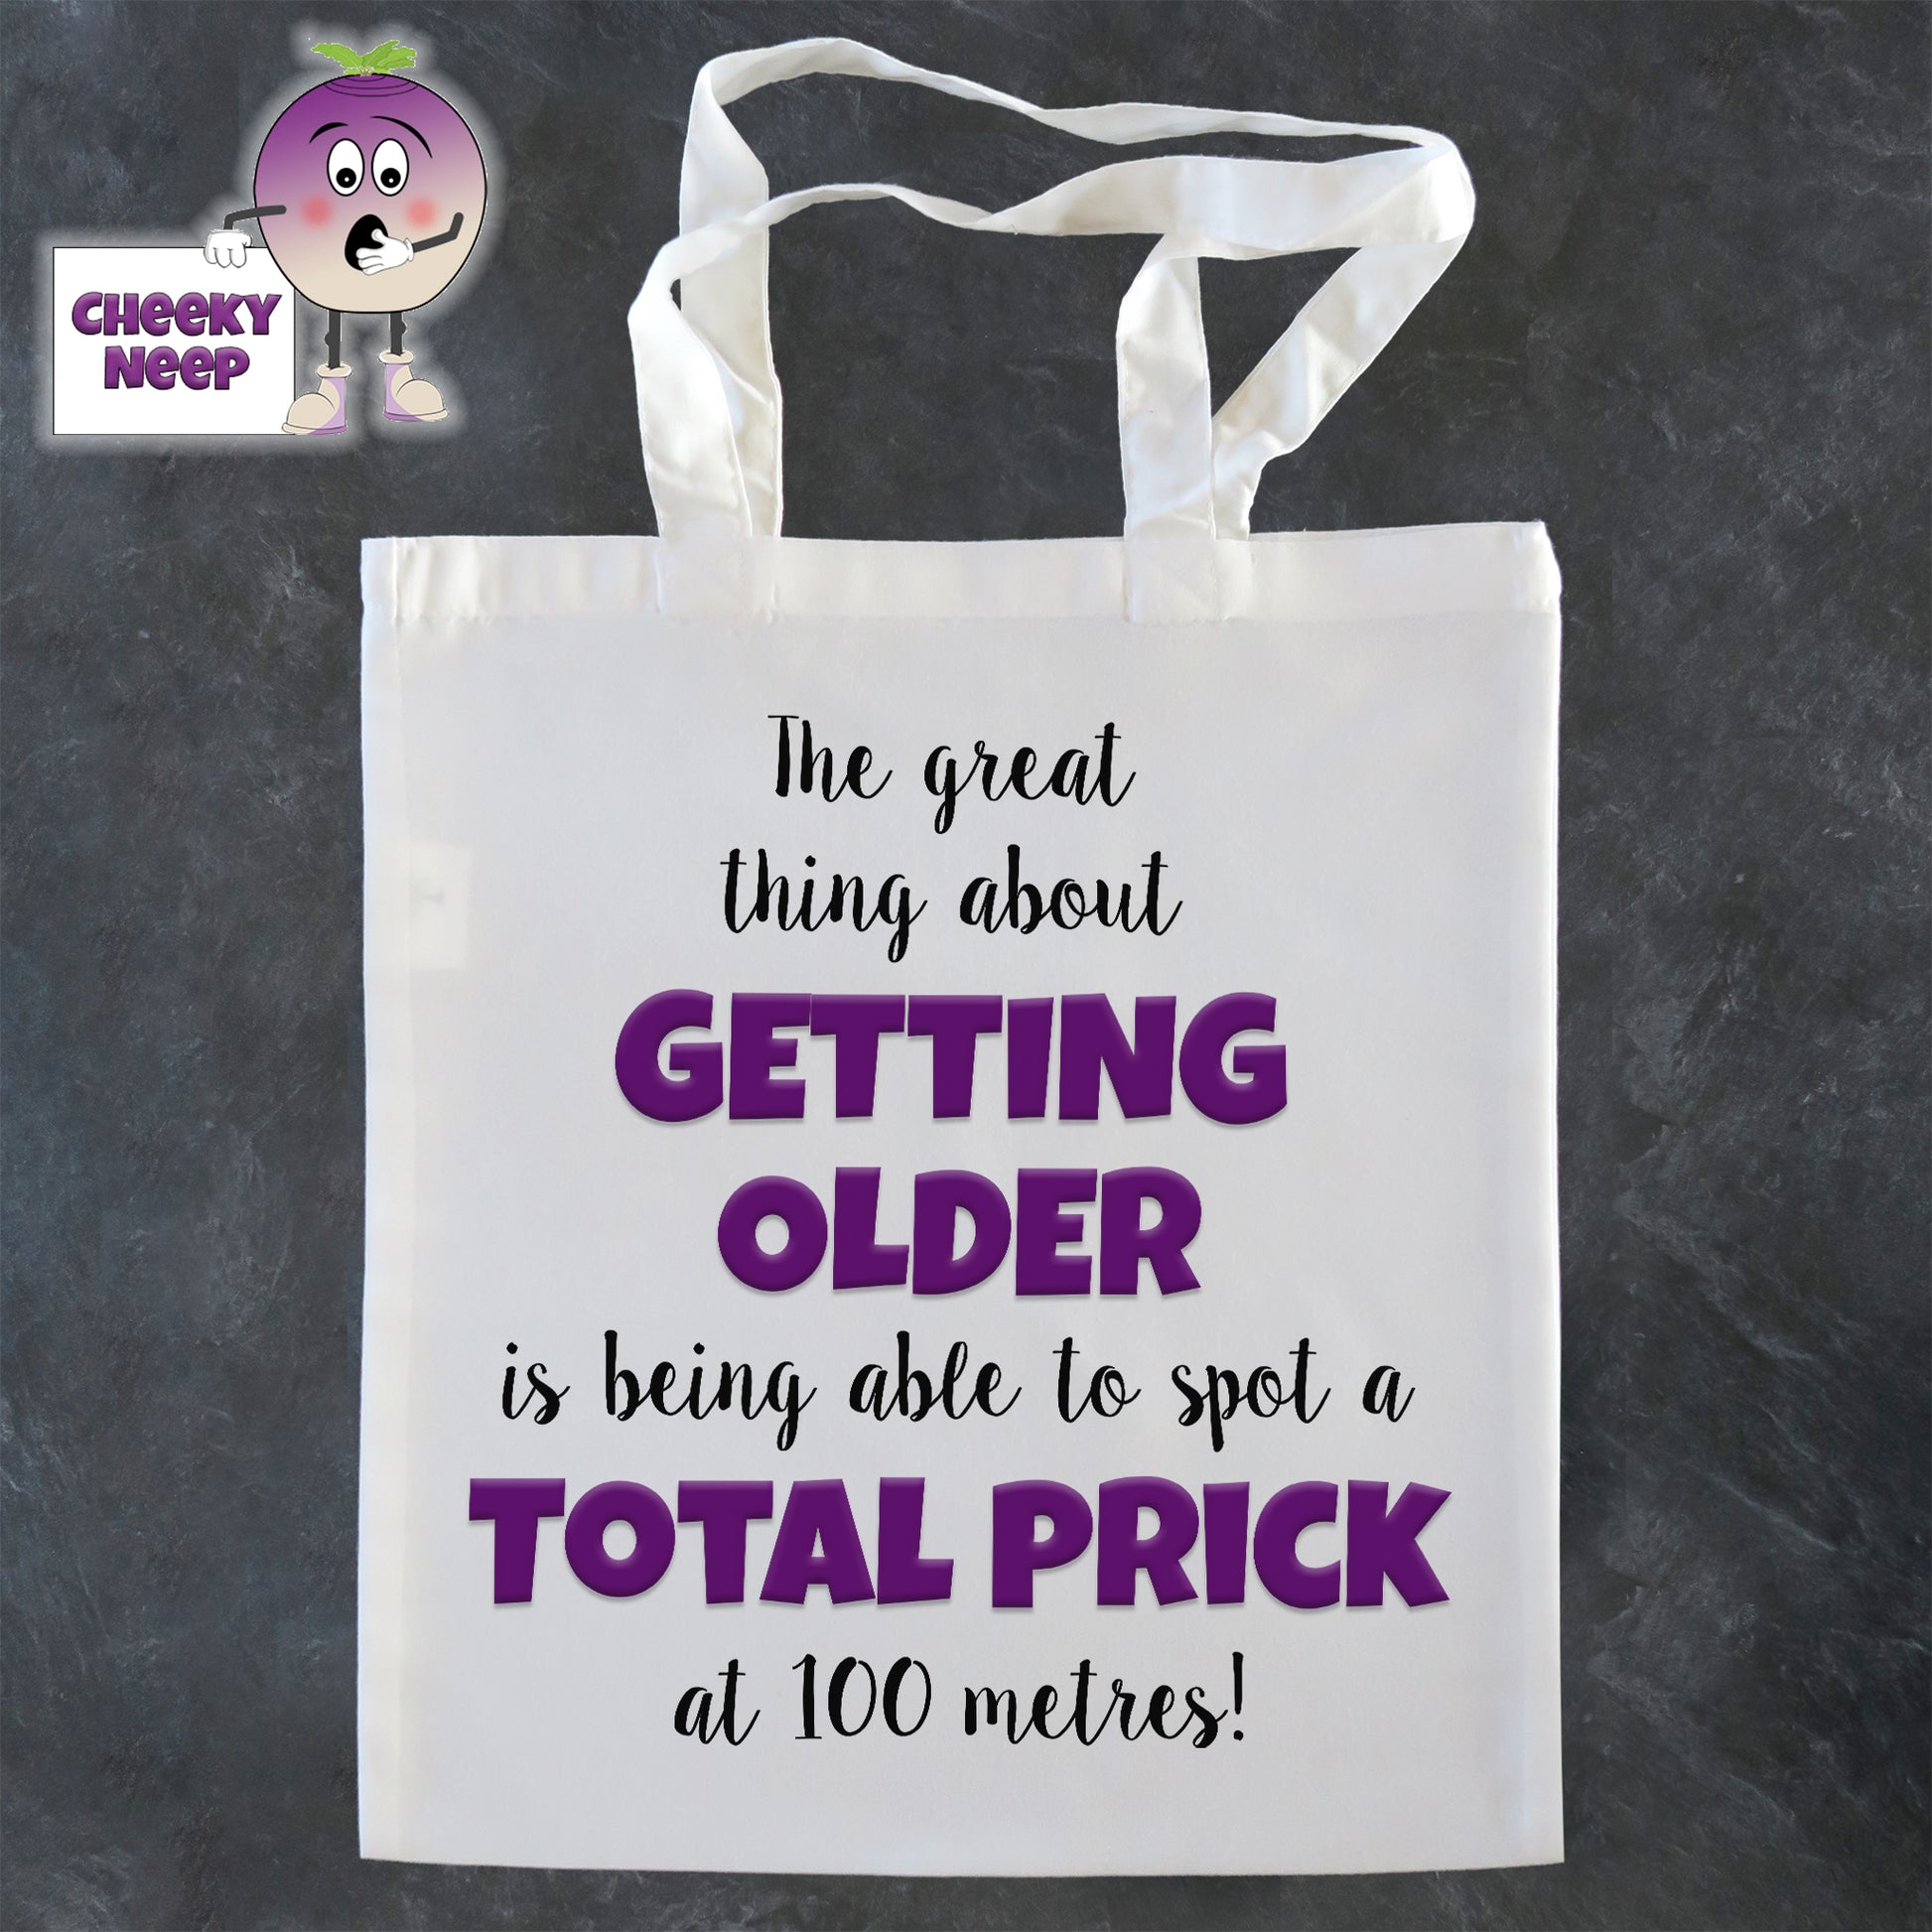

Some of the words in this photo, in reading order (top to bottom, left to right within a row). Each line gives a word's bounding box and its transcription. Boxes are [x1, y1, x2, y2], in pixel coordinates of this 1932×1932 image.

[768, 715, 893, 802] The
[924, 723, 1137, 835] great
[720, 849, 927, 962] thing
[960, 844, 1183, 935] about
[615, 988, 1288, 1125] GETTING
[717, 1167, 1202, 1297] OLDER
[502, 1342, 571, 1426] is
[605, 1330, 818, 1451] being
[850, 1330, 1023, 1423] able
[1053, 1337, 1142, 1424] to
[1172, 1338, 1331, 1453] spot
[1363, 1366, 1416, 1424] a
[469, 1476, 954, 1606] TOTAL
[992, 1476, 1451, 1610] PRICK
[674, 1659, 761, 1746] at
[792, 1654, 932, 1740] 100
[965, 1652, 1246, 1749] metres!
